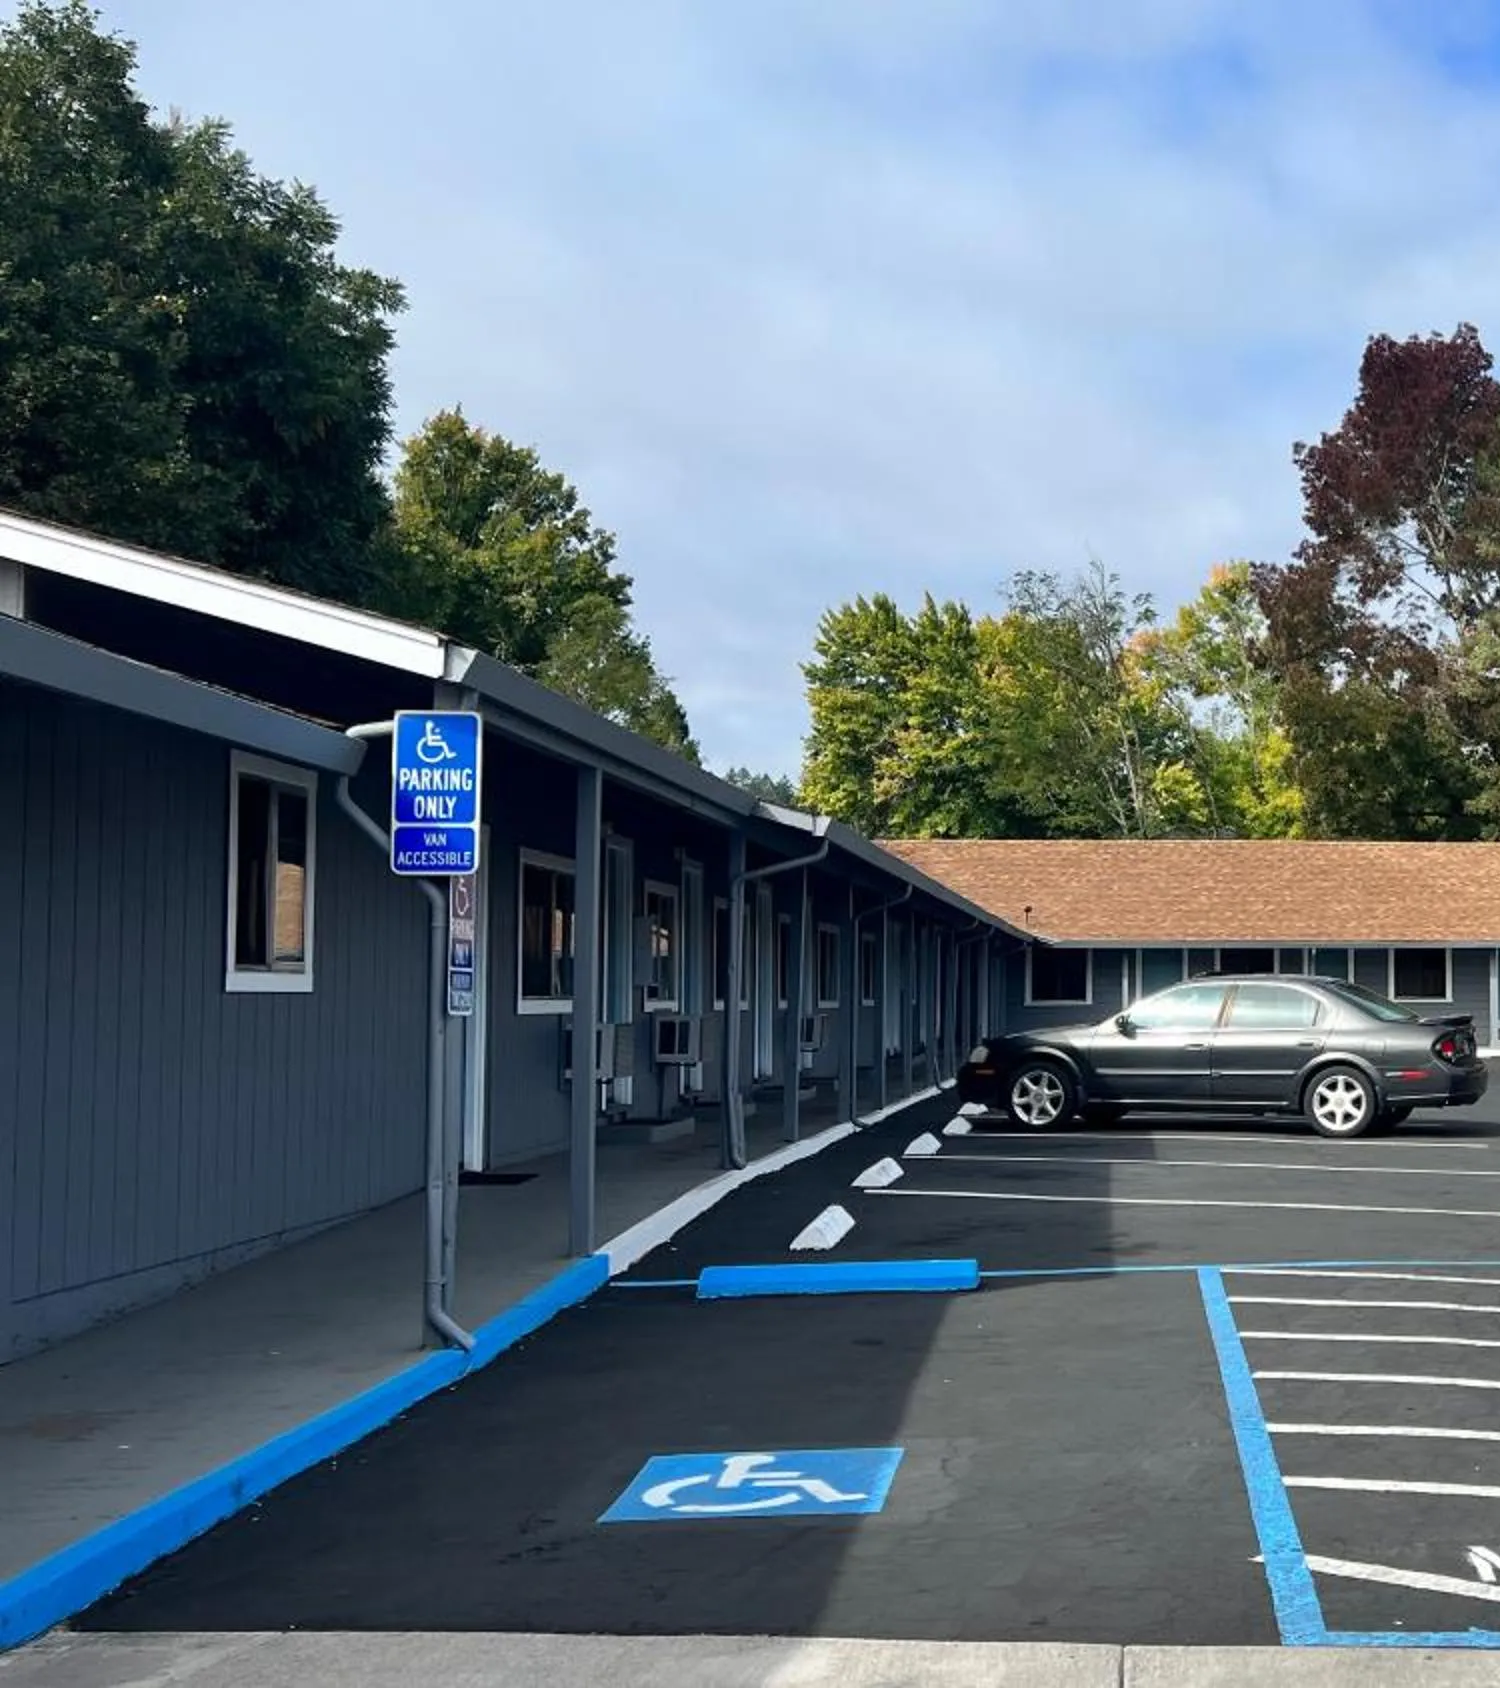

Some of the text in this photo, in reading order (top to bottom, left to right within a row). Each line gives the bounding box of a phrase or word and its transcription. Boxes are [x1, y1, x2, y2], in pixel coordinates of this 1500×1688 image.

[399, 767, 473, 791] PARKING
[413, 796, 457, 819] ONLY
[423, 832, 447, 847] VAN
[397, 851, 473, 866] ACCESSIBLE
